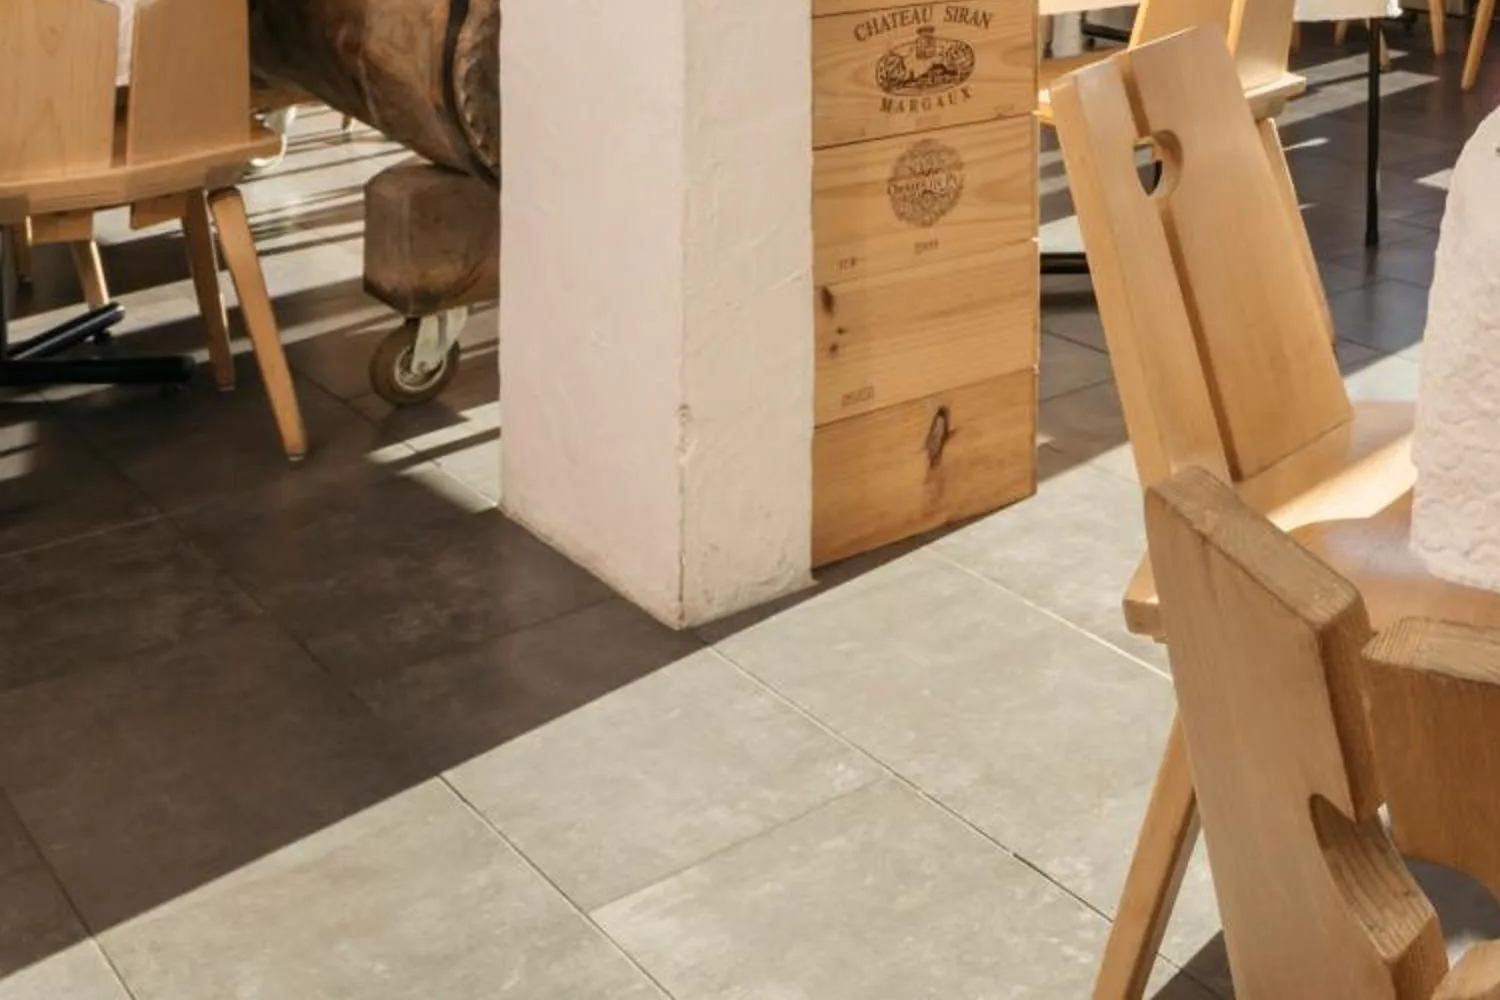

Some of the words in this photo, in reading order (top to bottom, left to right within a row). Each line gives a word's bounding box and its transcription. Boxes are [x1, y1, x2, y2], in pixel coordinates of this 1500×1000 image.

[853, 5, 933, 42] CHATEAU
[943, 5, 994, 30] SIRAN
[879, 85, 972, 113] MARGAUX
